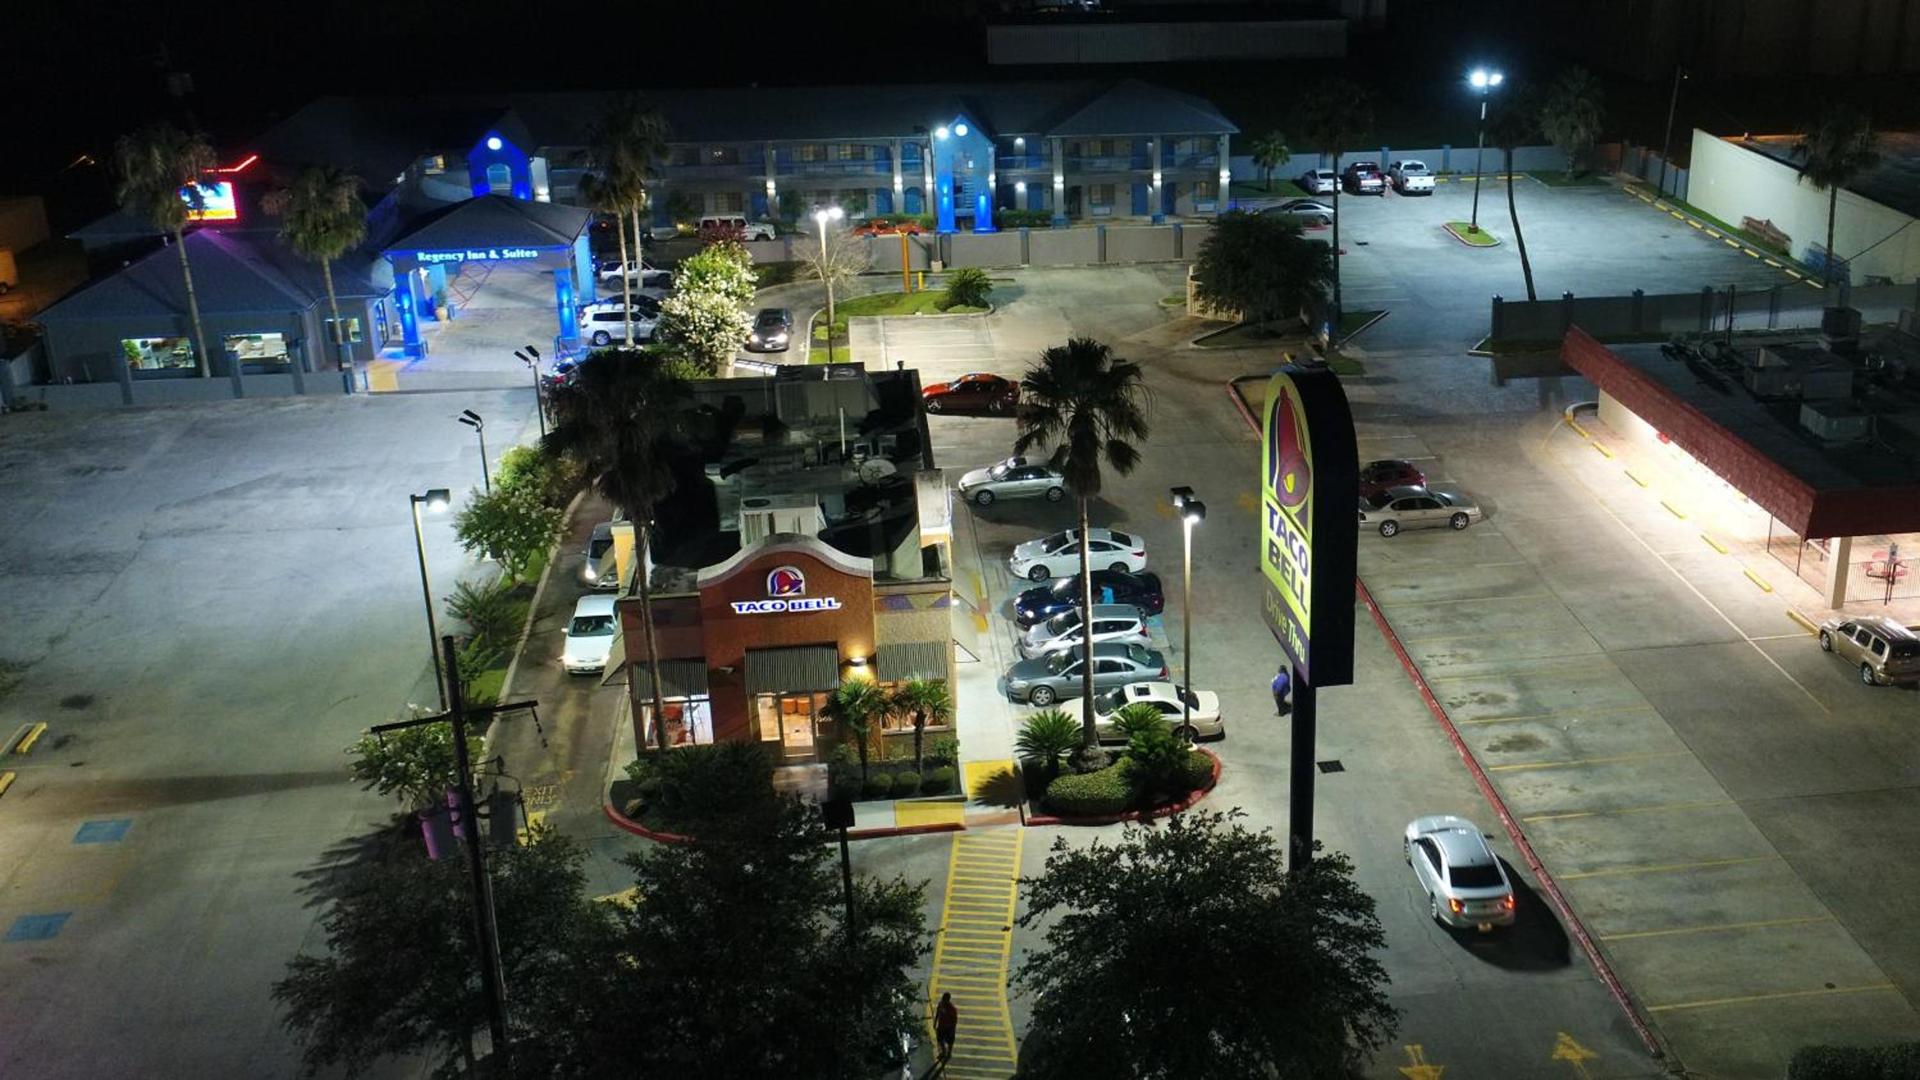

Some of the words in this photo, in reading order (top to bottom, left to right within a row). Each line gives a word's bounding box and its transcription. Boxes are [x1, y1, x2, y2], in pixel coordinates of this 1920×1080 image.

[417, 252, 464, 262] Regency
[466, 250, 487, 260] Inn
[488, 249, 500, 259] &
[502, 248, 538, 258] Suites
[1266, 501, 1308, 577] TACO
[733, 602, 786, 613] TACO
[790, 599, 838, 611] BELL
[1268, 538, 1308, 614] BELL
[1266, 592, 1287, 634] Drive
[1288, 619, 1306, 664] Thru
